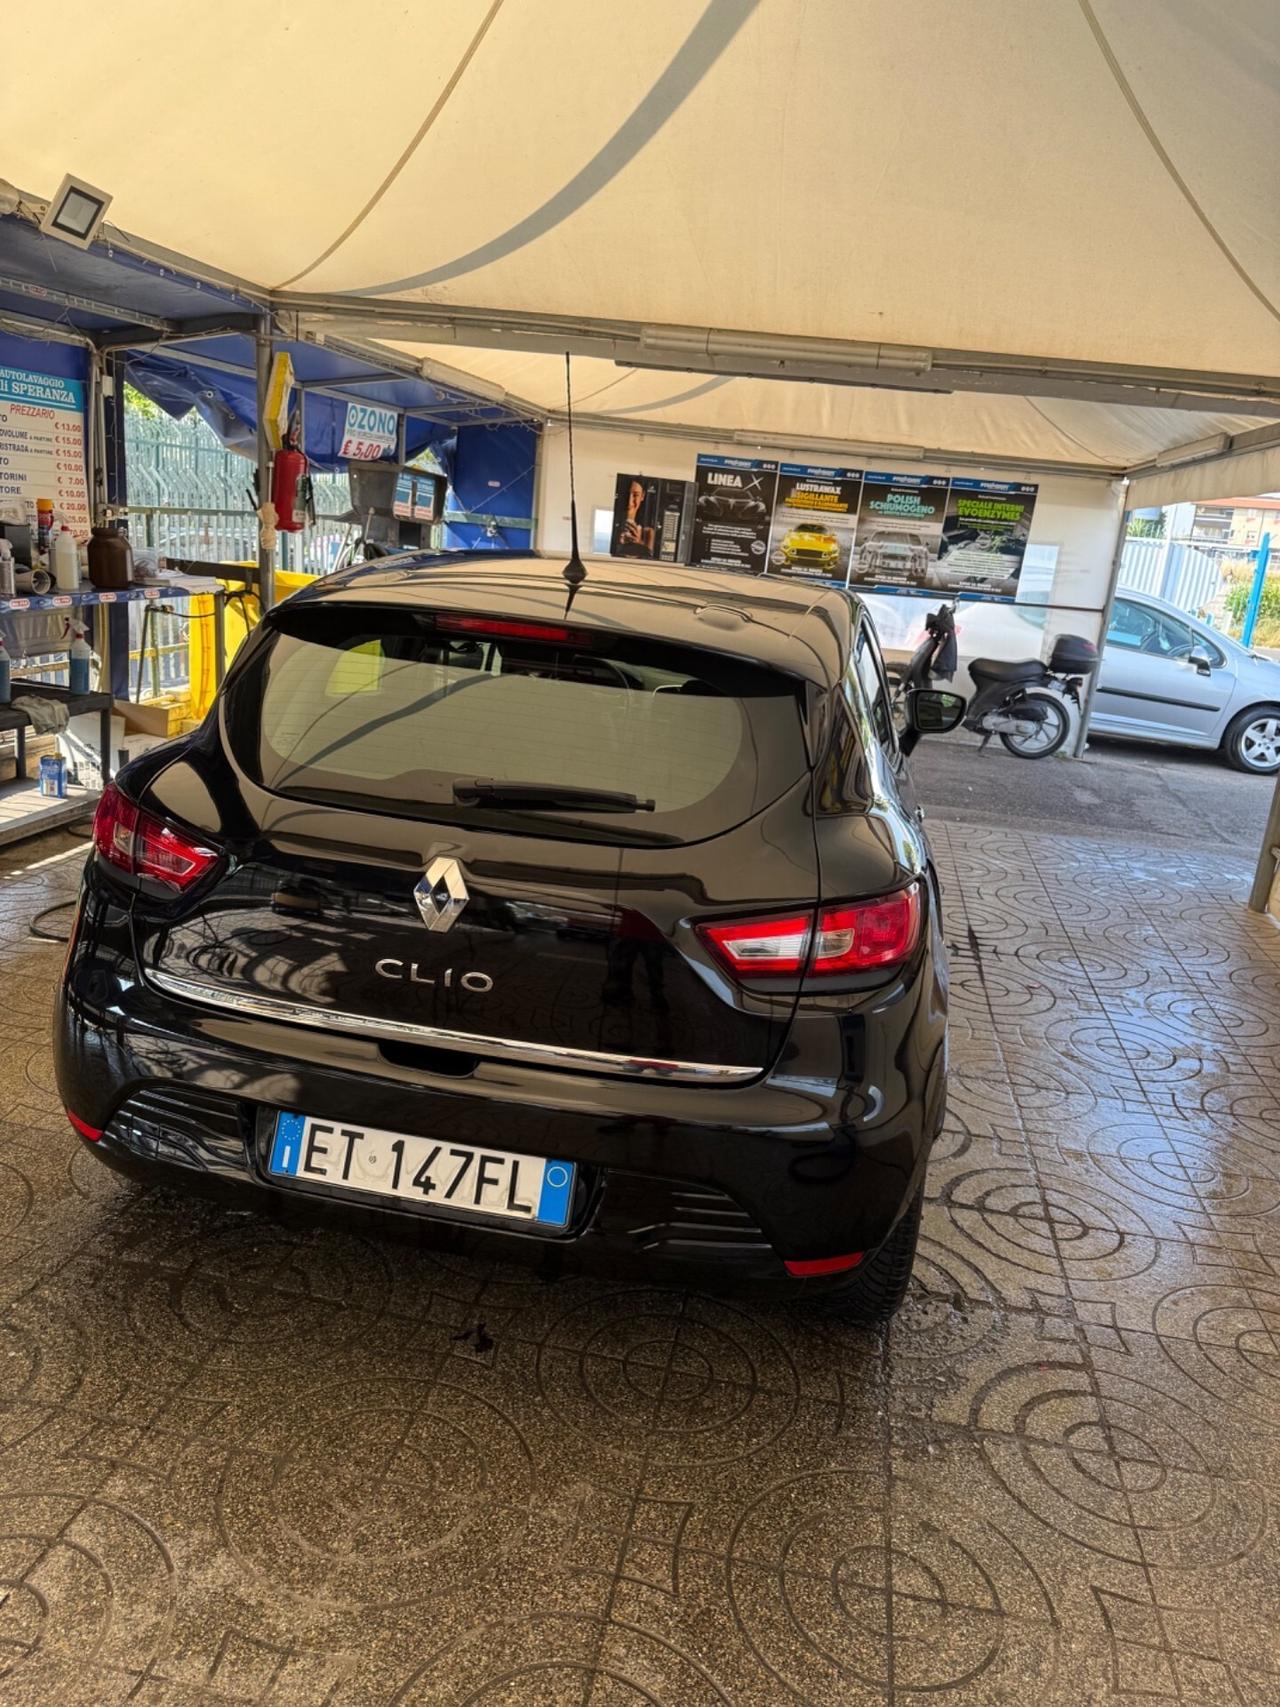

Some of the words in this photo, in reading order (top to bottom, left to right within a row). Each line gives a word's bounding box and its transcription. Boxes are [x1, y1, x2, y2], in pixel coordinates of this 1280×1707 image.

[0, 369, 65, 388] AUTOLAVAGGIO
[12, 381, 76, 403] SPERANZA
[10, 403, 55, 420] PREZZARIO
[55, 422, 60, 430] €
[62, 423, 81, 432] 13.00
[348, 405, 396, 436] OZONO
[64, 464, 83, 472] 10.00
[69, 477, 84, 485] 7.00
[707, 472, 742, 488] LINEA
[744, 474, 764, 492] X
[66, 490, 86, 498] 10.00
[887, 494, 921, 506] POLISH
[869, 501, 935, 514] SCHIUMOGENO
[958, 500, 993, 510] SPECIALE
[958, 508, 1020, 520] EVOENZYMES
[375, 958, 494, 992] CLIO
[303, 1123, 364, 1180] ET
[392, 1140, 532, 1214] 147FL
